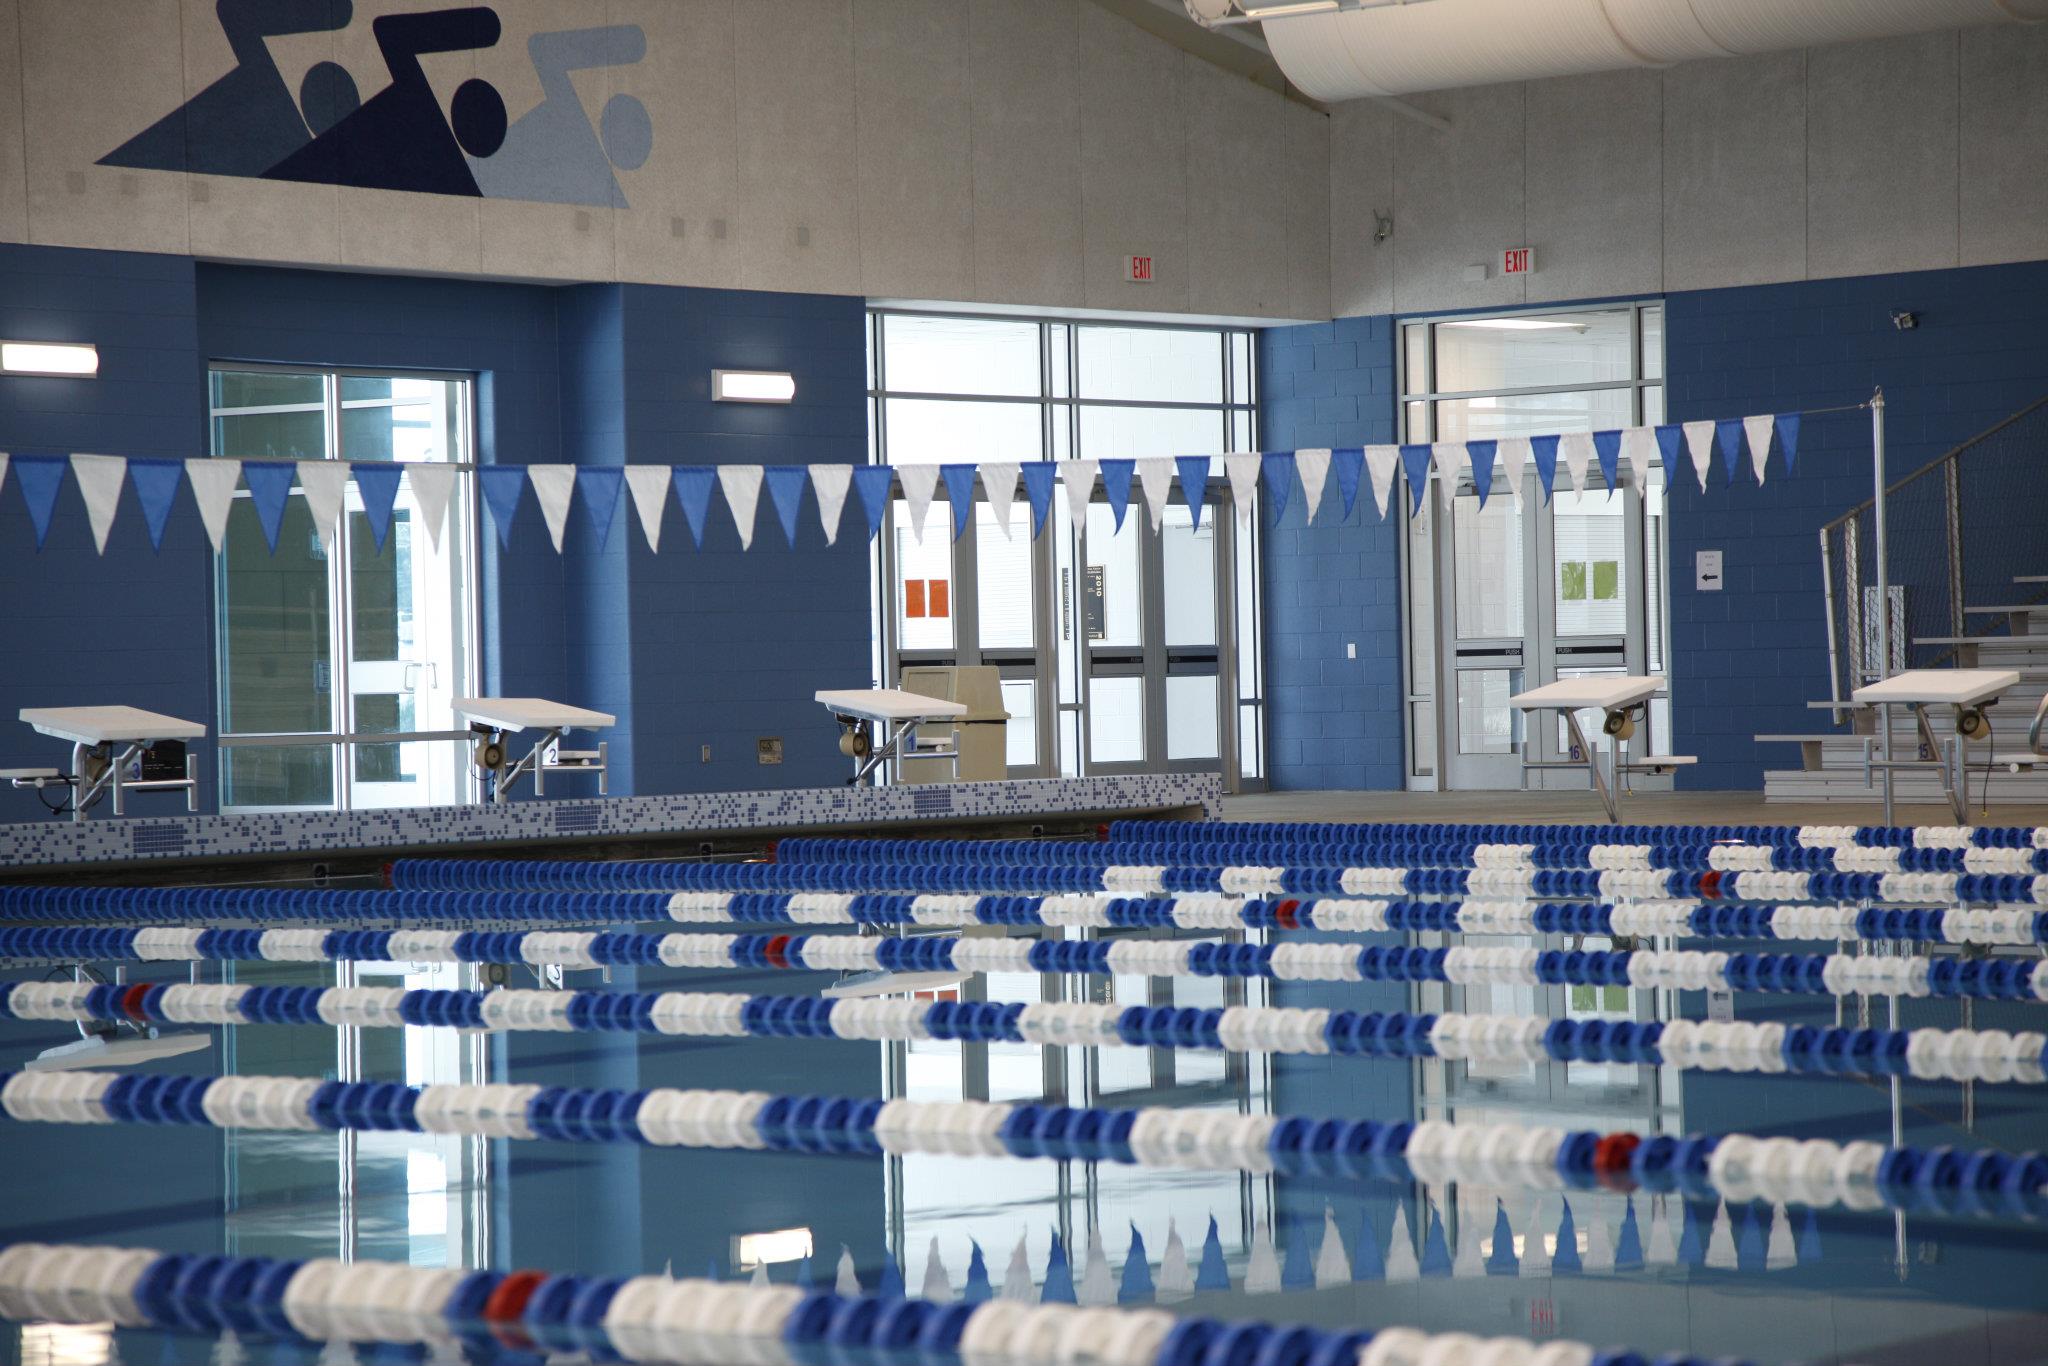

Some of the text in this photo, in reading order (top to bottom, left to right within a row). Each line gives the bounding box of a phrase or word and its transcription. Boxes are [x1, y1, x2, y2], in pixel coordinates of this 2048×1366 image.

[1133, 256, 1151, 279] EXIT
[1505, 249, 1528, 273] EXIT
[1505, 648, 1520, 656] PUSH
[1557, 647, 1572, 655] PUSH
[550, 748, 557, 763] 2
[1568, 744, 1580, 760] 16
[1918, 743, 1929, 759] 15
[132, 762, 140, 779] 3
